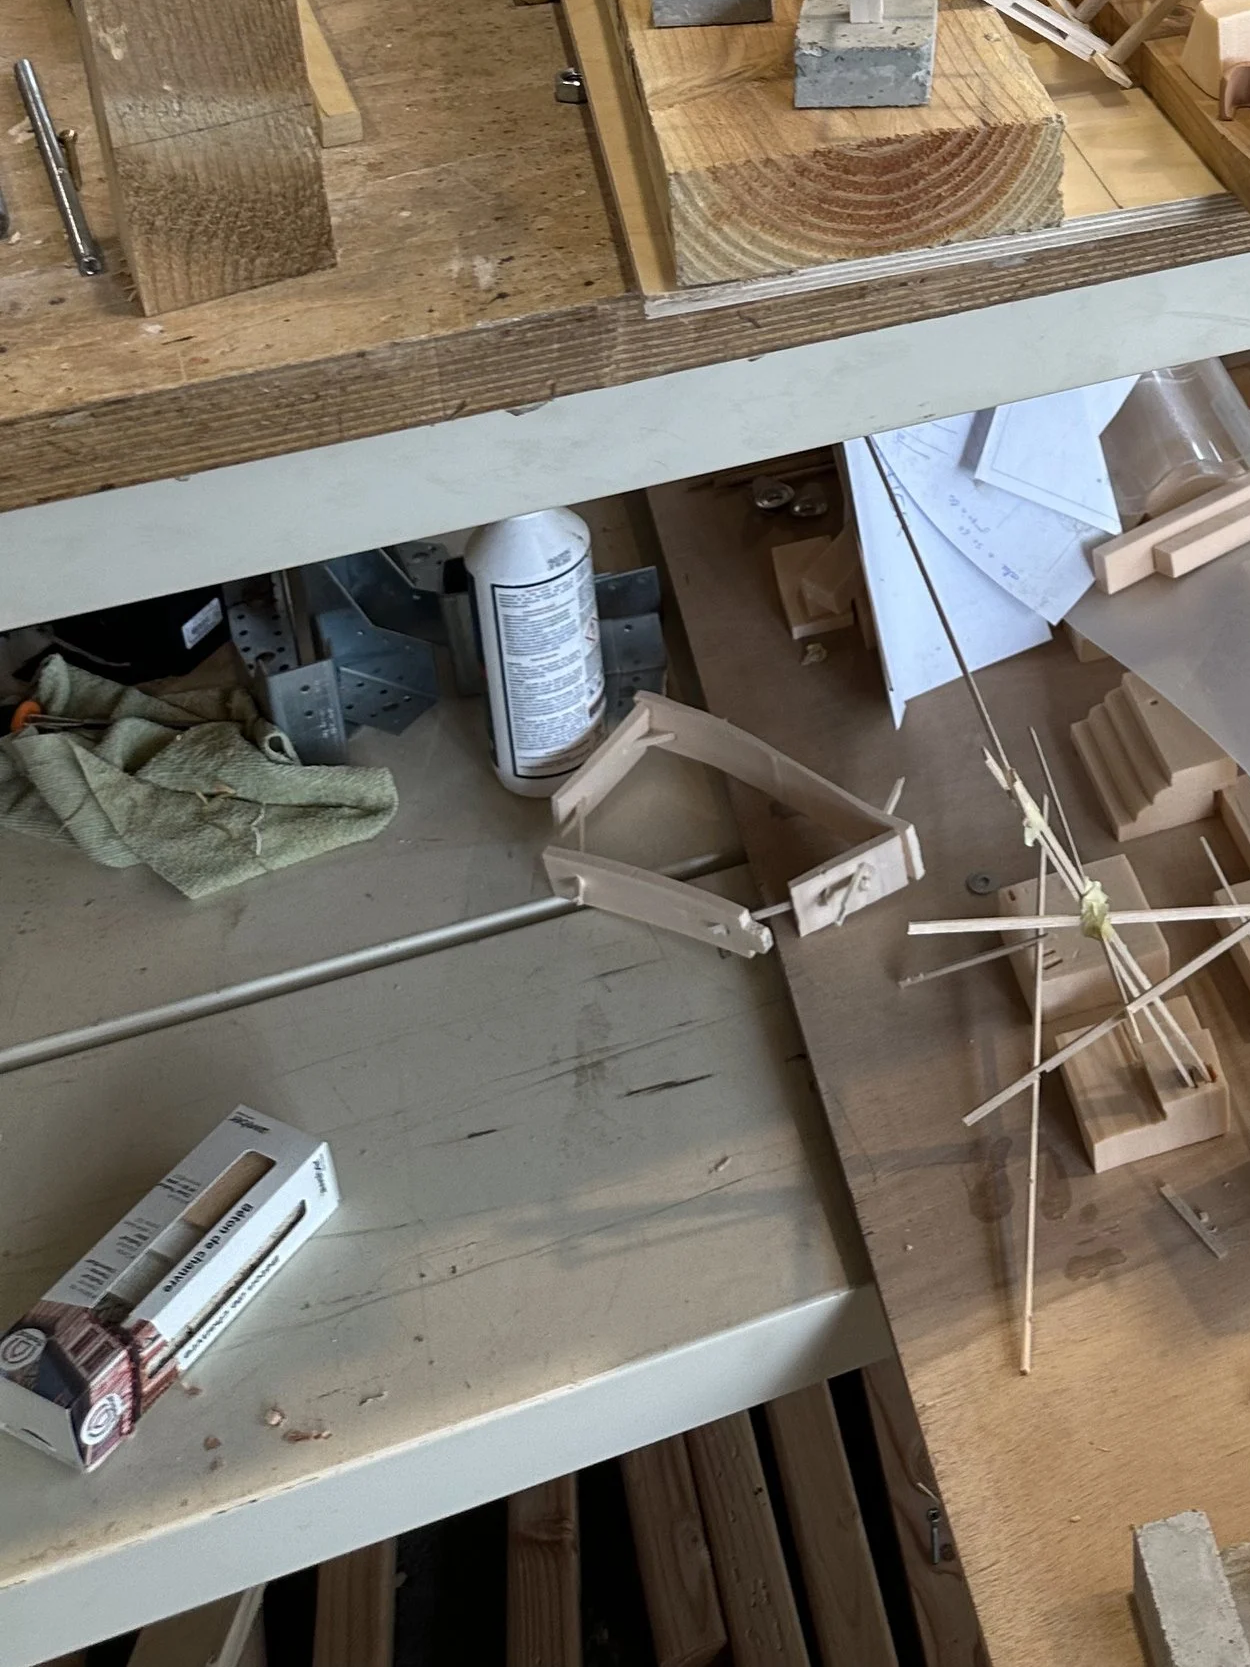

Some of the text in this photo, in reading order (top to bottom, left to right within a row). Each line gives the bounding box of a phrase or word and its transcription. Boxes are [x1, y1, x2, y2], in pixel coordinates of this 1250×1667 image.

[163, 1202, 254, 1292] Béton de chanvre
